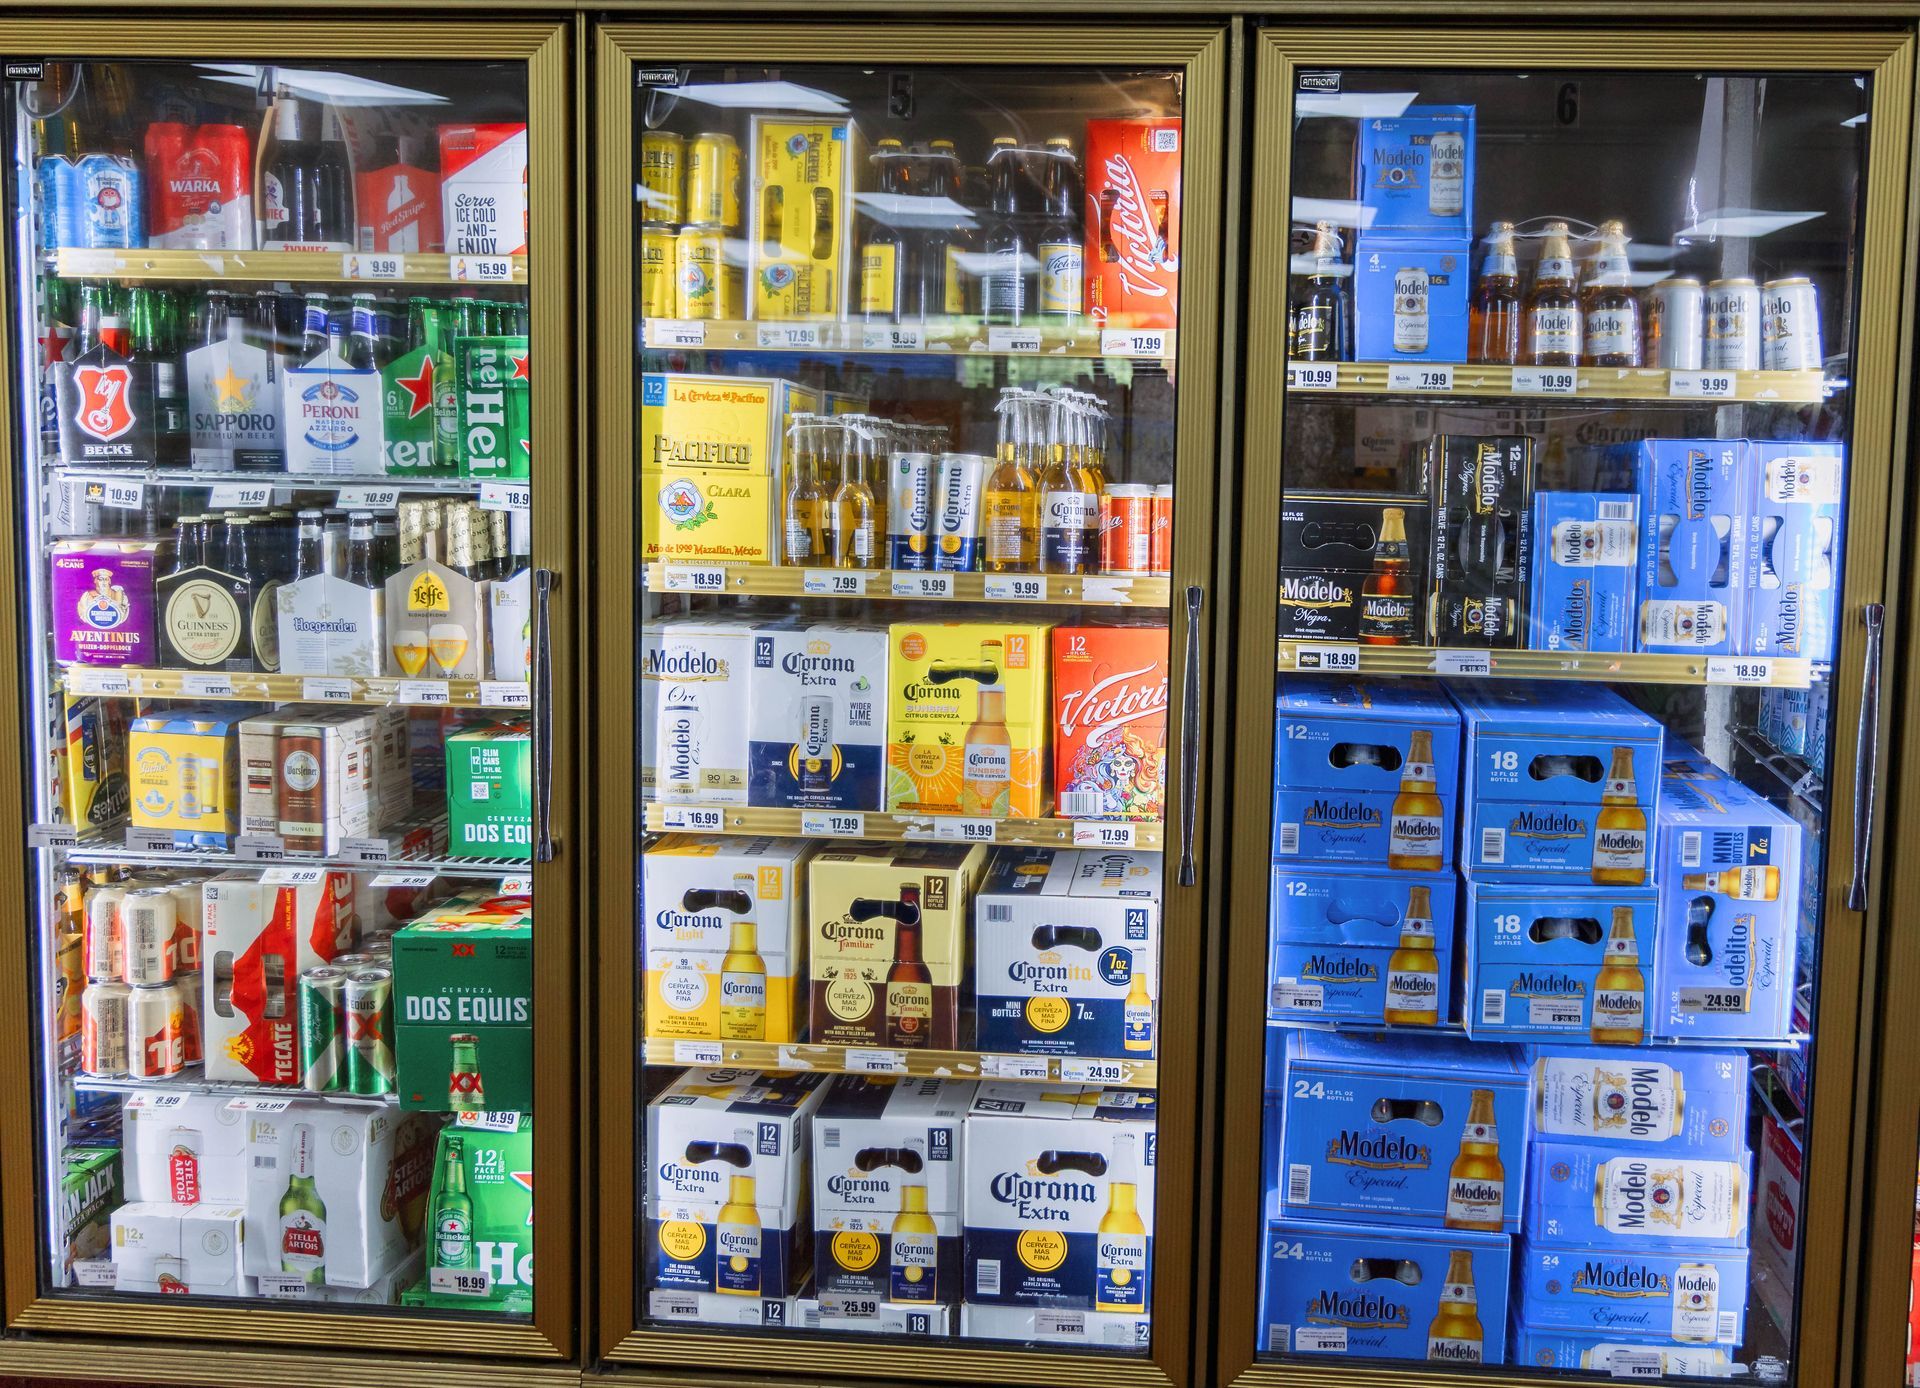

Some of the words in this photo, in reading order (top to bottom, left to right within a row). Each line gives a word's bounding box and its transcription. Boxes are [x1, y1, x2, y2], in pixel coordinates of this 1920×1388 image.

[1302, 78, 1337, 87] ANTHONY
[1557, 83, 1578, 125] 6
[1371, 120, 1382, 131] 4
[1373, 149, 1424, 166] Modelo
[170, 181, 221, 193] WARKA
[455, 193, 496, 207] Serve
[456, 208, 471, 223] ICE
[473, 208, 496, 223] COLD
[466, 224, 486, 237] AND
[458, 238, 496, 254] ENJOY
[1369, 254, 1379, 265] 4
[648, 383, 662, 394] 12
[674, 389, 686, 401] La
[688, 389, 720, 402] Cerveza
[387, 391, 396, 404] 6
[302, 404, 359, 418] PERONI
[196, 414, 275, 431] SAPPORO
[84, 445, 132, 455] BECK'S
[654, 434, 752, 464] PACIFICO
[1510, 445, 1521, 461] 12
[1722, 450, 1733, 465] 12
[1483, 446, 1502, 512] Modelo
[1693, 457, 1713, 520] Modelo
[942, 466, 962, 532] Corona
[960, 484, 972, 520] Extra
[647, 544, 663, 554] Año
[665, 545, 674, 553] de
[414, 586, 444, 607] Leffe
[1283, 577, 1342, 601] Modelo
[1366, 601, 1405, 616] Modelo
[1564, 586, 1584, 642] Modelo
[177, 620, 228, 631] GUINNESS
[294, 618, 356, 633] Hoegaarden
[70, 630, 140, 643] AVENTINUS
[1548, 635, 1559, 650] 18
[758, 642, 770, 655] 12
[1009, 637, 1024, 653] 12
[649, 649, 717, 674] Modelo
[782, 651, 855, 677] Corona
[801, 674, 836, 686] Extra
[903, 683, 960, 703] Corona
[850, 702, 871, 710] WIDER
[905, 704, 960, 712] SUNBREW
[850, 710, 871, 720] LIME
[806, 705, 820, 756] Corona
[820, 718, 828, 743] Extra
[1286, 724, 1307, 740] 12
[670, 719, 690, 780] Modelo
[472, 756, 480, 764] 12
[1491, 751, 1518, 770] 18
[1314, 800, 1373, 821] Modelo
[1397, 820, 1439, 837] Modelo
[1518, 812, 1578, 832] Modelo
[1712, 831, 1733, 864] MINI
[1733, 831, 1744, 864] BOTTLES
[929, 879, 943, 894] 12
[1286, 881, 1307, 896] 12
[656, 910, 723, 932] Corona
[1128, 912, 1144, 925] 24
[1493, 914, 1521, 933] 18
[821, 922, 884, 942] Corona
[838, 941, 874, 952] Familiar
[1008, 960, 1092, 984] Coronita
[1310, 955, 1369, 977] Modelo
[843, 972, 857, 980] 1925
[1519, 972, 1577, 993] Modelo
[1033, 980, 1068, 993] Extra
[406, 996, 450, 1021] DOS
[458, 997, 528, 1022] EQUIS
[992, 1009, 1021, 1017] BOTTLES
[1006, 1001, 1021, 1009] MINI
[274, 1023, 292, 1081] TECATE
[1721, 1061, 1732, 1080] 24
[1293, 1080, 1325, 1099] 24
[1630, 1067, 1660, 1136] Modelo
[762, 1125, 776, 1141] 12
[933, 1131, 947, 1145] 18
[1340, 1129, 1418, 1161] Modelo
[475, 1150, 496, 1166] 12
[175, 1159, 185, 1201] ARTOIS
[185, 1159, 196, 1201] STELLA
[660, 1162, 720, 1183] Corona
[675, 1182, 705, 1193] Extra
[827, 1174, 890, 1195] Corona
[990, 1172, 1097, 1206] Corona
[1455, 1184, 1498, 1201] Modelo
[844, 1192, 875, 1204] Extra
[1618, 1162, 1648, 1229] Modelo
[676, 1212, 690, 1220] 1925
[1018, 1201, 1070, 1222] Extra
[1547, 1219, 1557, 1236] 24
[289, 1233, 318, 1243] STELLA
[436, 1232, 471, 1241] Heineken
[289, 1241, 318, 1250] ARTOIS
[1273, 1241, 1303, 1259] 24
[1542, 1255, 1559, 1266] 24
[1584, 1261, 1660, 1290] Modelo
[1678, 1274, 1716, 1292] Modelo
[768, 1304, 780, 1318] 12
[1319, 1290, 1397, 1320] Modelo
